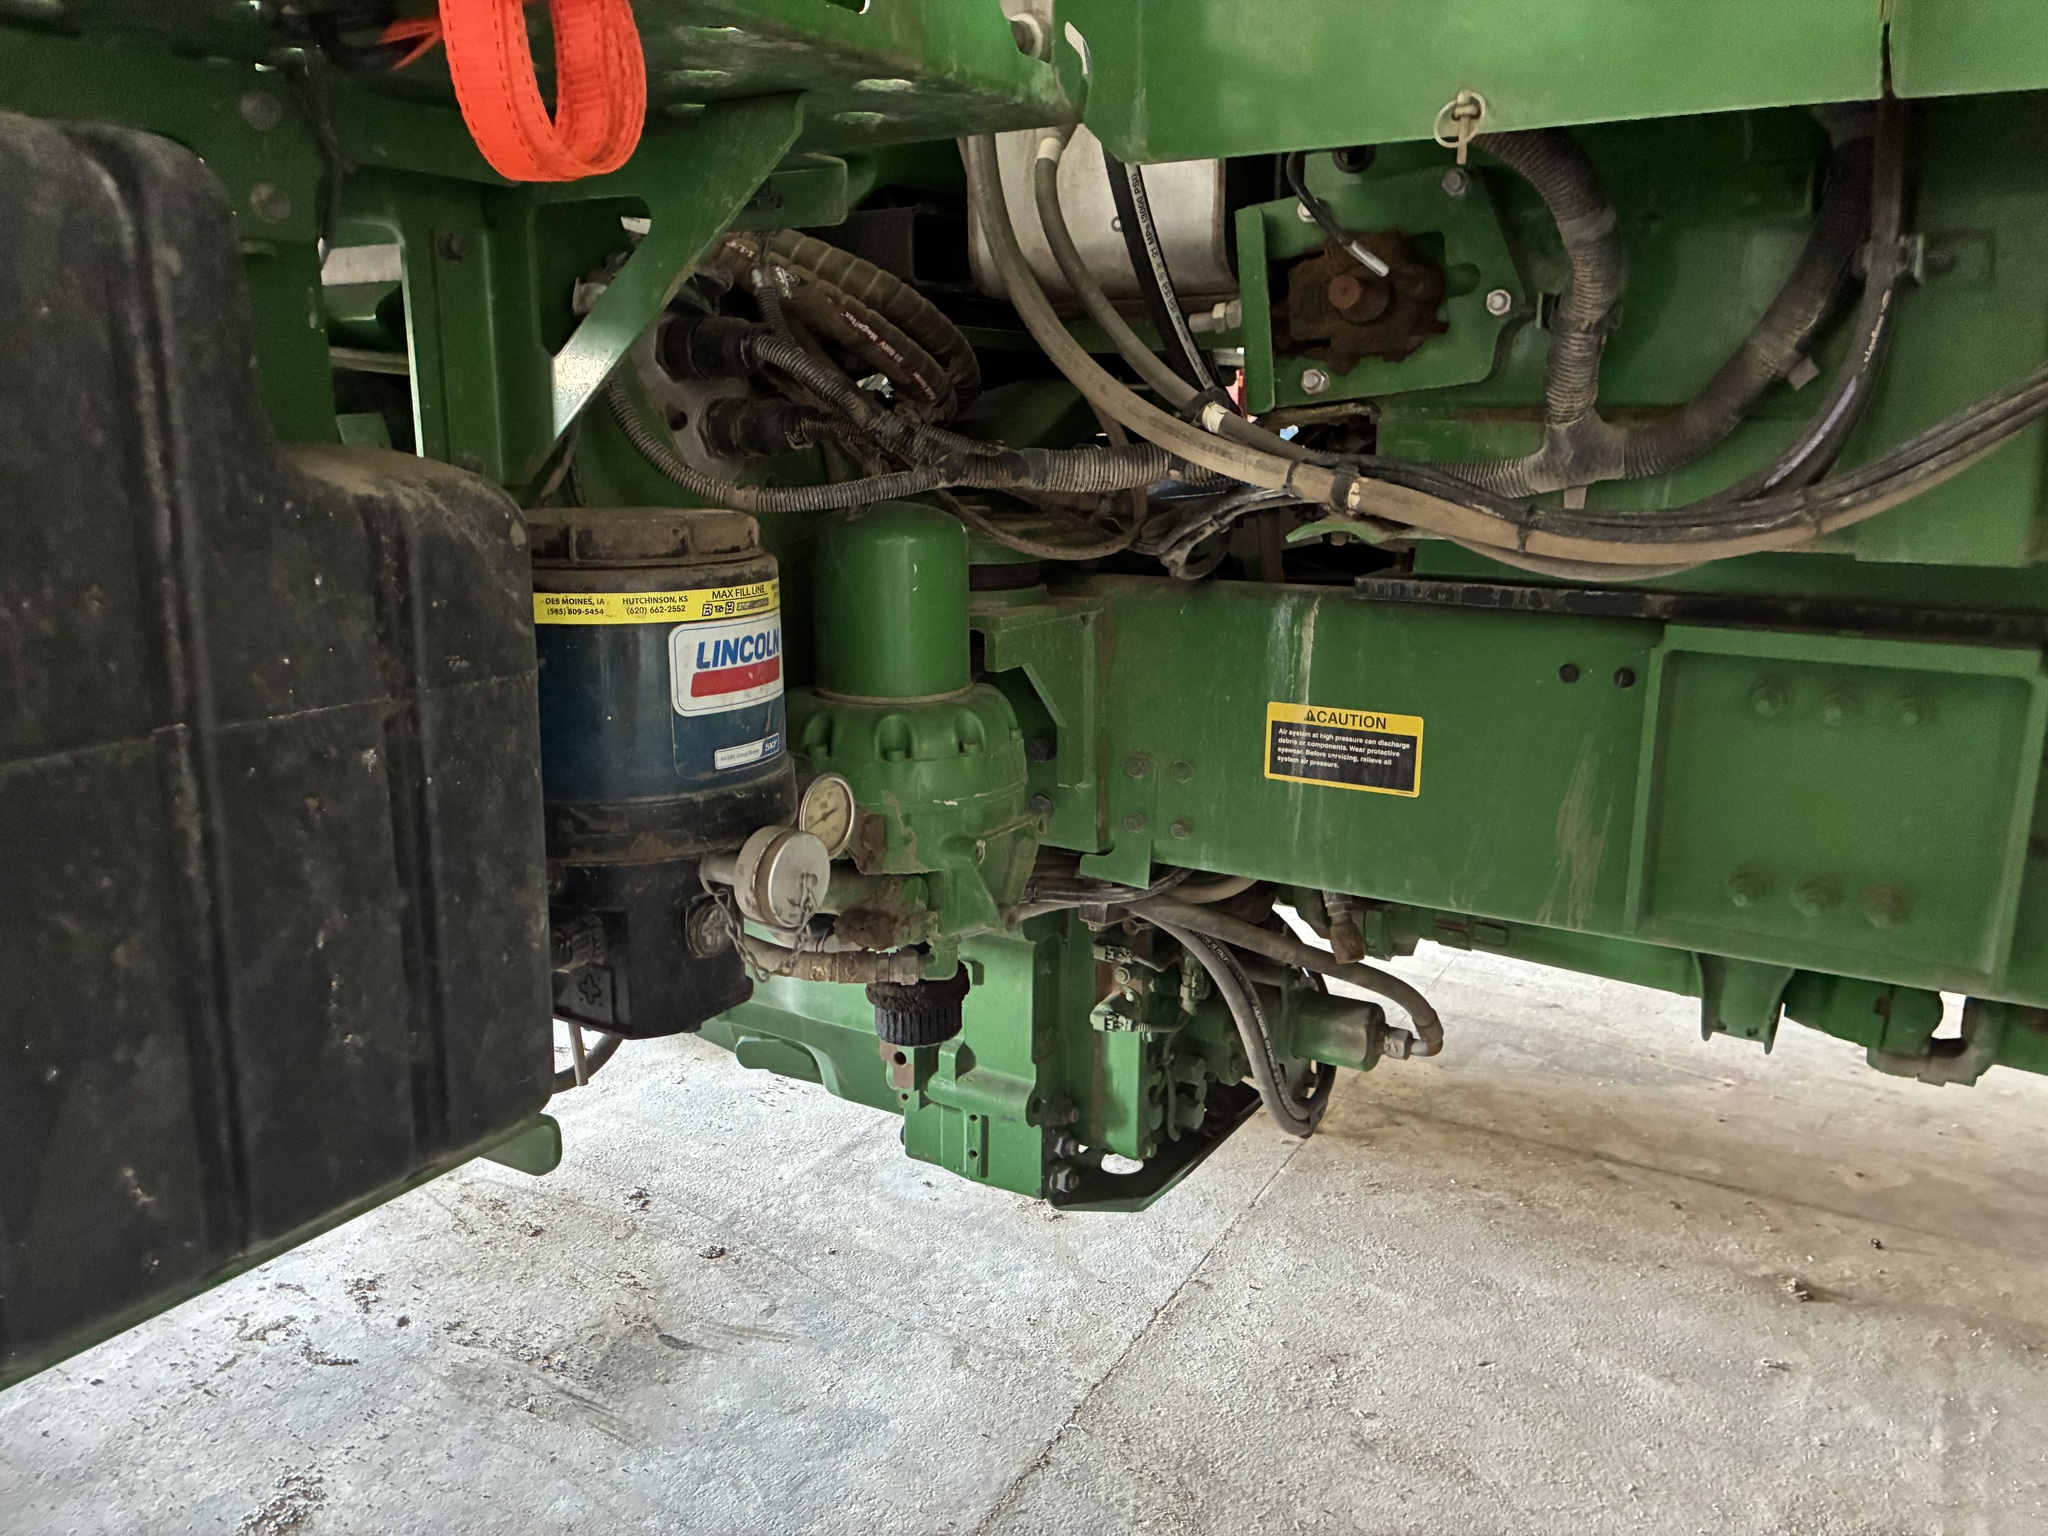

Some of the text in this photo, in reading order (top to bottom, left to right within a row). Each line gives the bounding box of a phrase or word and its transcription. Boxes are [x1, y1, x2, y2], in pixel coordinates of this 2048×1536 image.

[1136, 196, 1149, 223] (3000
[1145, 223, 1155, 246] MPa
[622, 595, 689, 605] HUTCHINSON, KS
[711, 589, 734, 600] MAX
[735, 587, 751, 598] FILL
[752, 585, 765, 594] LINE
[545, 597, 560, 605] DES
[561, 597, 595, 606] MOINES,
[567, 608, 604, 616] 809-5454
[626, 604, 686, 616] (620) 662-2552
[696, 627, 780, 670] LINCOLN
[1317, 710, 1387, 730] CAUTION
[765, 739, 778, 752] SKF
[1277, 737, 1298, 745] debris
[1307, 741, 1349, 751] components.
[1348, 745, 1366, 753] Wear
[1366, 748, 1401, 757] protective
[1289, 730, 1312, 738] system
[1319, 732, 1334, 741] high
[1334, 735, 1363, 744] pressure
[1377, 739, 1411, 750] discharge
[1277, 755, 1300, 763] system
[1309, 760, 1340, 769] pressure.
[1305, 749, 1327, 758] Before
[1360, 756, 1383, 765] relieve
